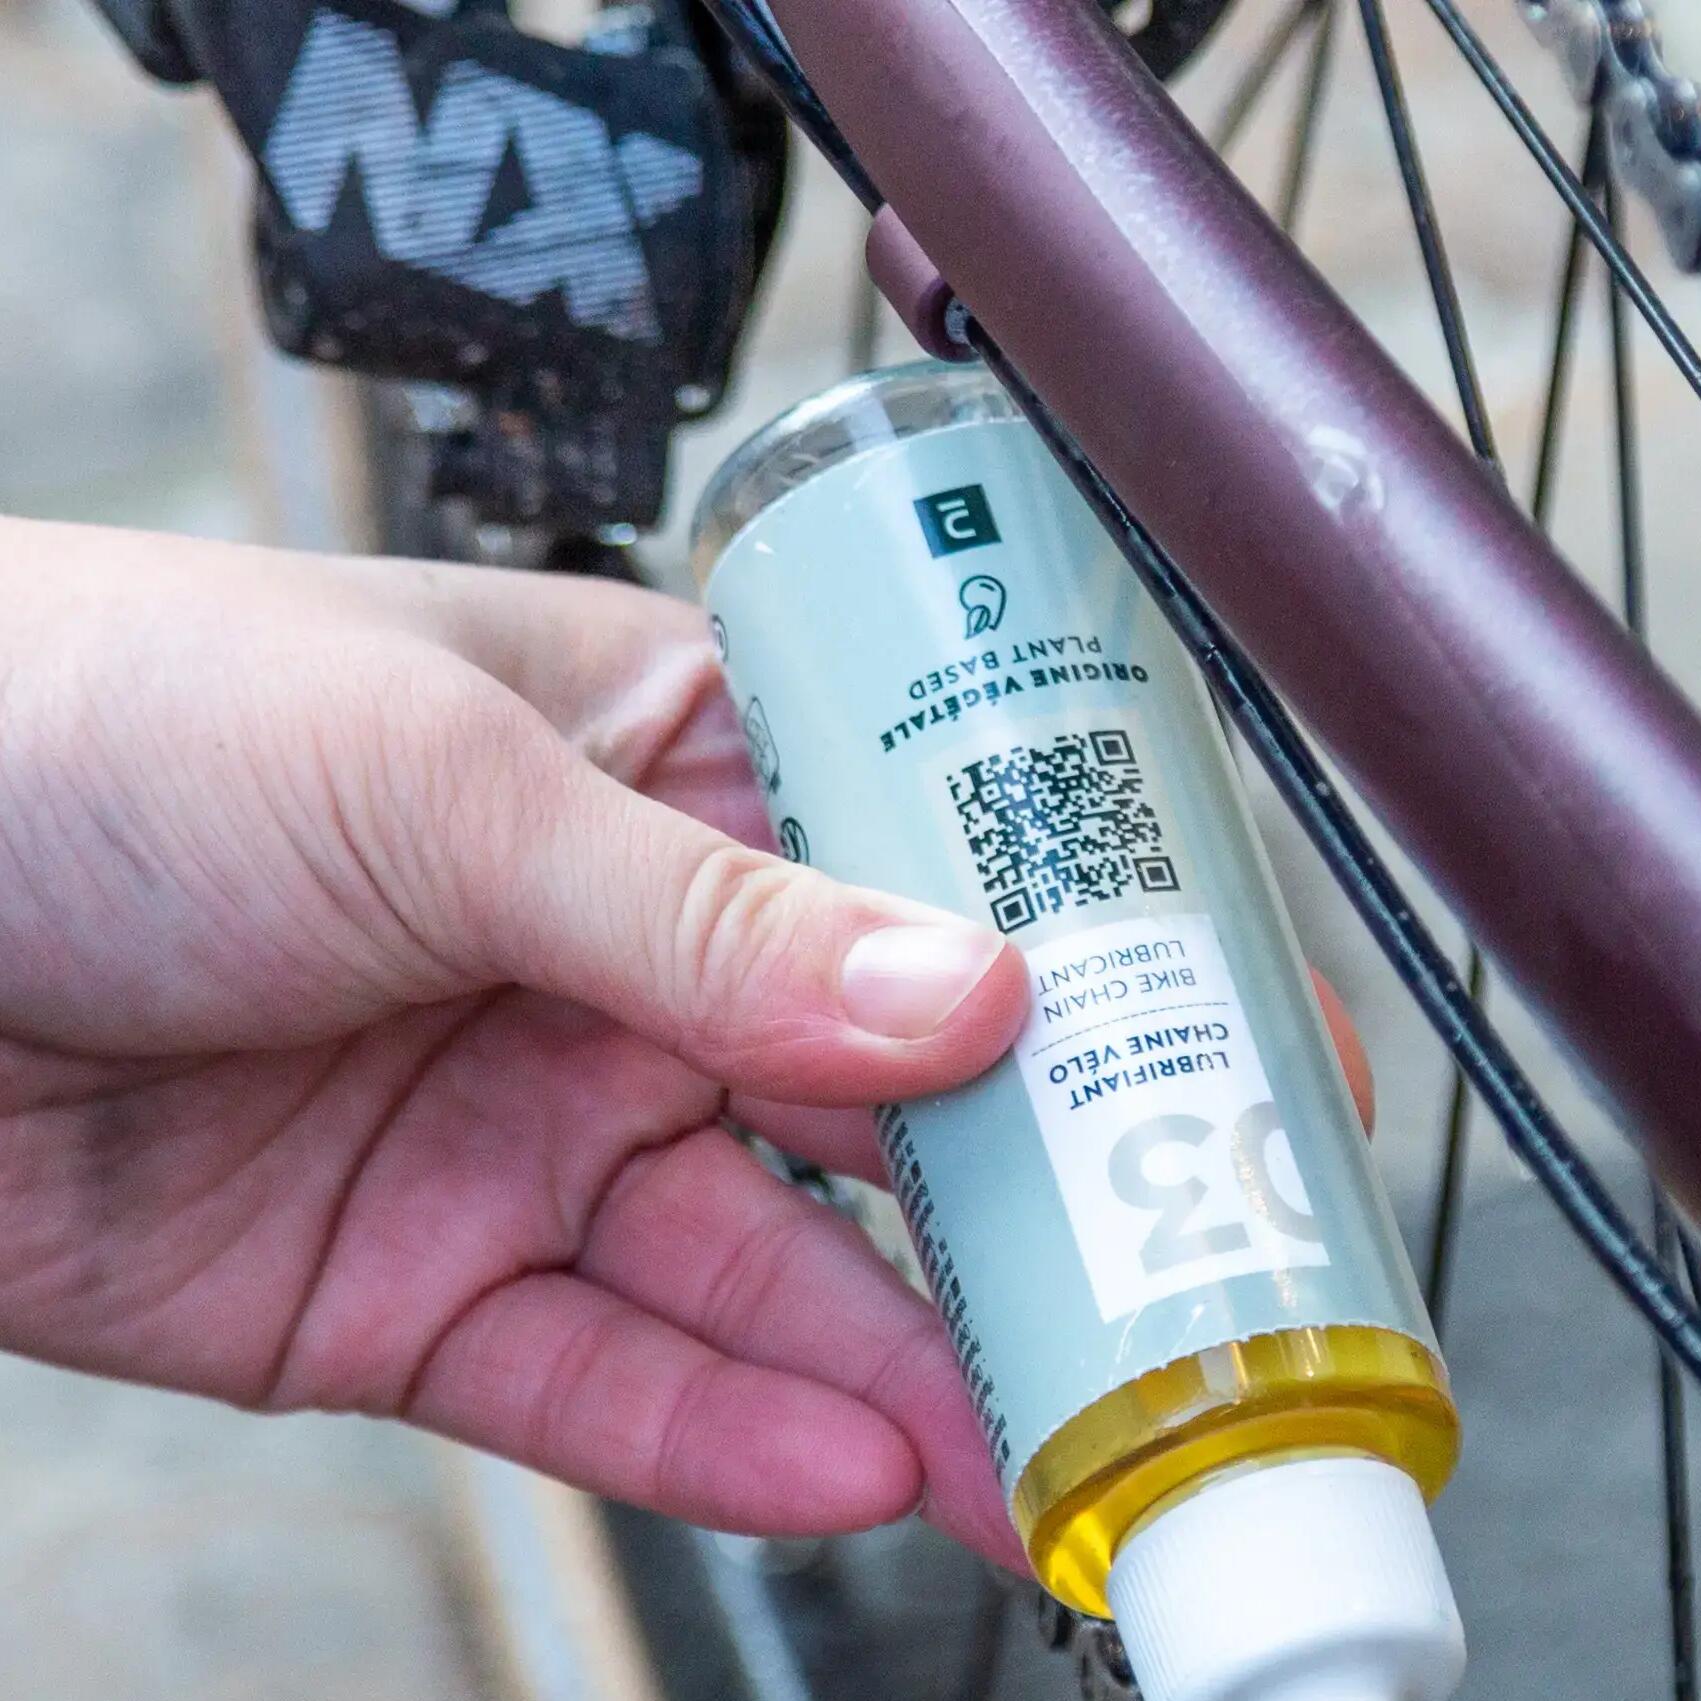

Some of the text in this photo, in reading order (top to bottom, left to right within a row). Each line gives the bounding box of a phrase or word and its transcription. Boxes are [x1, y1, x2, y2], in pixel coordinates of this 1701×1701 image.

[908, 636, 1102, 700] PLANT BASED
[879, 662, 1149, 753] ORIGINE VÉGÉTALE
[1038, 939, 1187, 997] LUBRICANT
[1043, 967, 1198, 1024] BIKE CHAIN
[1048, 1022, 1230, 1086] CHAINE VÉLO
[1068, 1051, 1230, 1111] LUBRIFIANT
